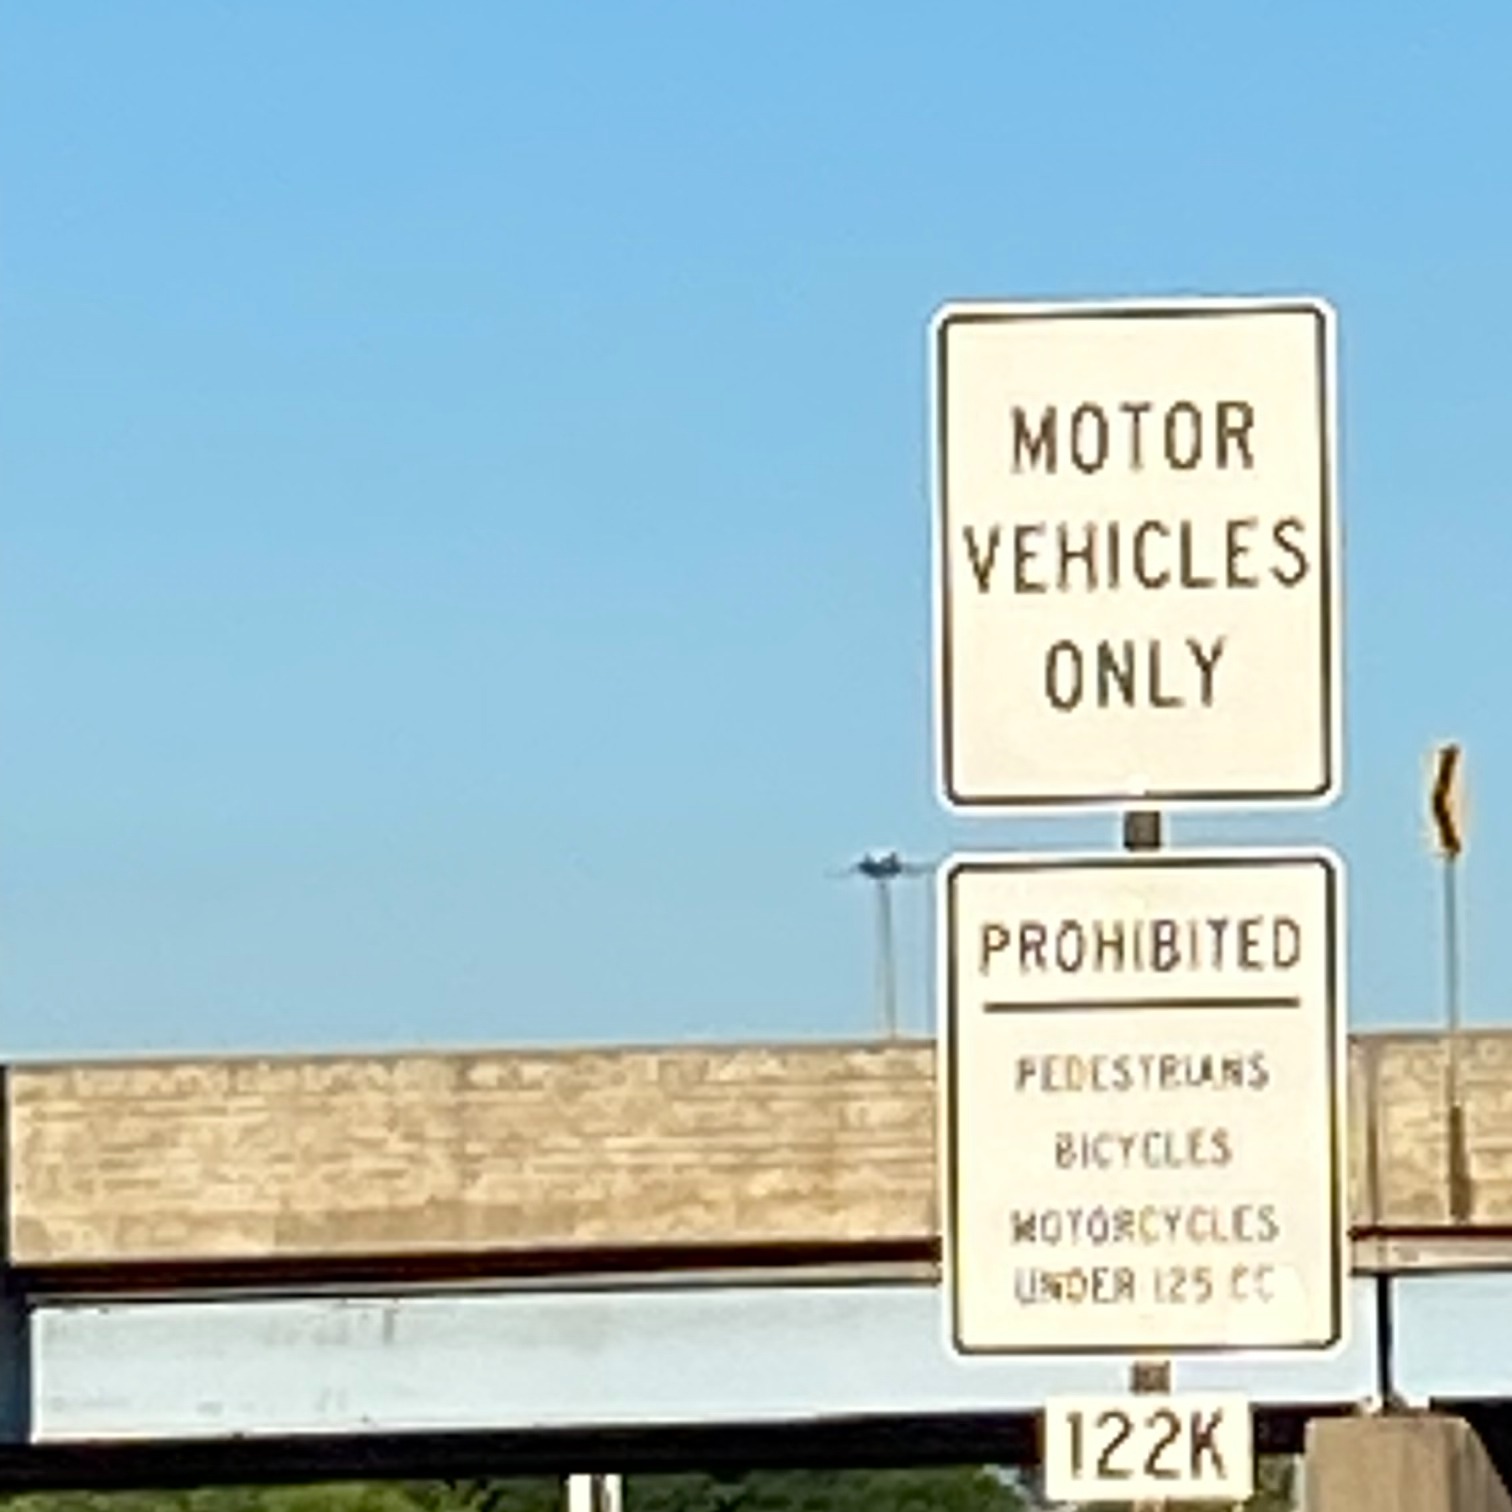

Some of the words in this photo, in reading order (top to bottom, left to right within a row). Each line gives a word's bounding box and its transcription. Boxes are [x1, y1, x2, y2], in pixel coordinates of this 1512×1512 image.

[1010, 400, 1255, 475] MOTOR
[963, 515, 1311, 594] VEHICLES
[1044, 636, 1228, 712] ONLY
[978, 914, 1301, 977] PROHIBITED
[1014, 1051, 1270, 1093] PEDESTRIANS
[1054, 1127, 1234, 1170] BICYCLES
[1009, 1204, 1280, 1247] MOTORCYCLES
[1013, 1266, 1136, 1307] UNDER
[1153, 1266, 1213, 1304] 125
[1230, 1265, 1276, 1302] CC
[1065, 1407, 1229, 1480] 122K
